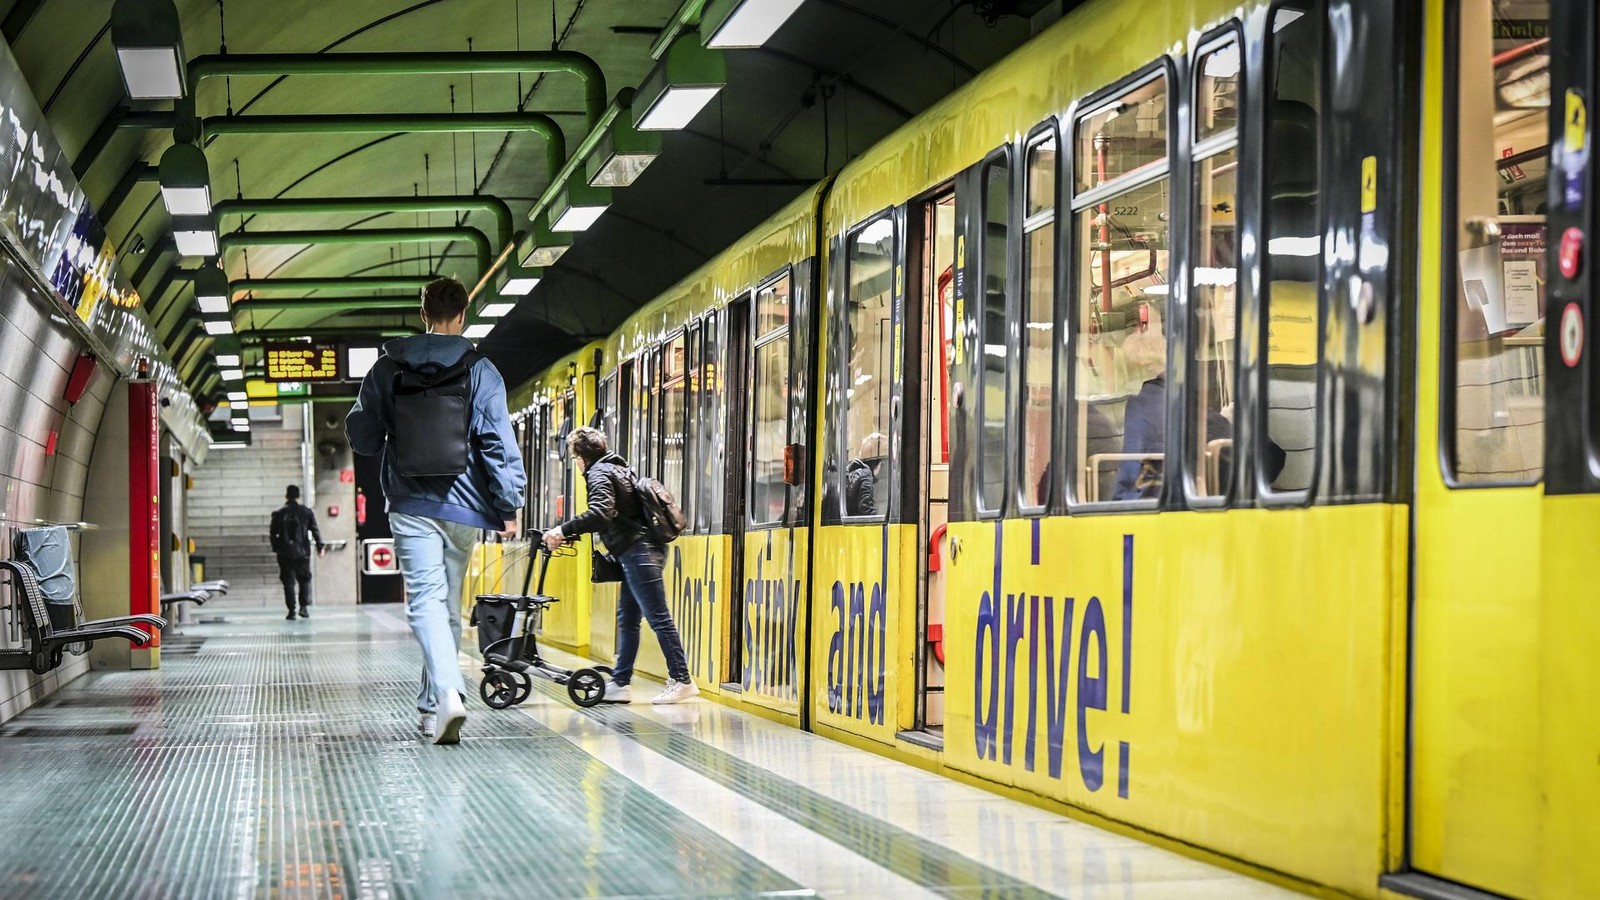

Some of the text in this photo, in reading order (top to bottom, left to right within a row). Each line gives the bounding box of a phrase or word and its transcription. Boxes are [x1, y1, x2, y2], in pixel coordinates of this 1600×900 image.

[1114, 206, 1138, 216] 5222
[672, 518, 1134, 800] Don't stink and drive!
